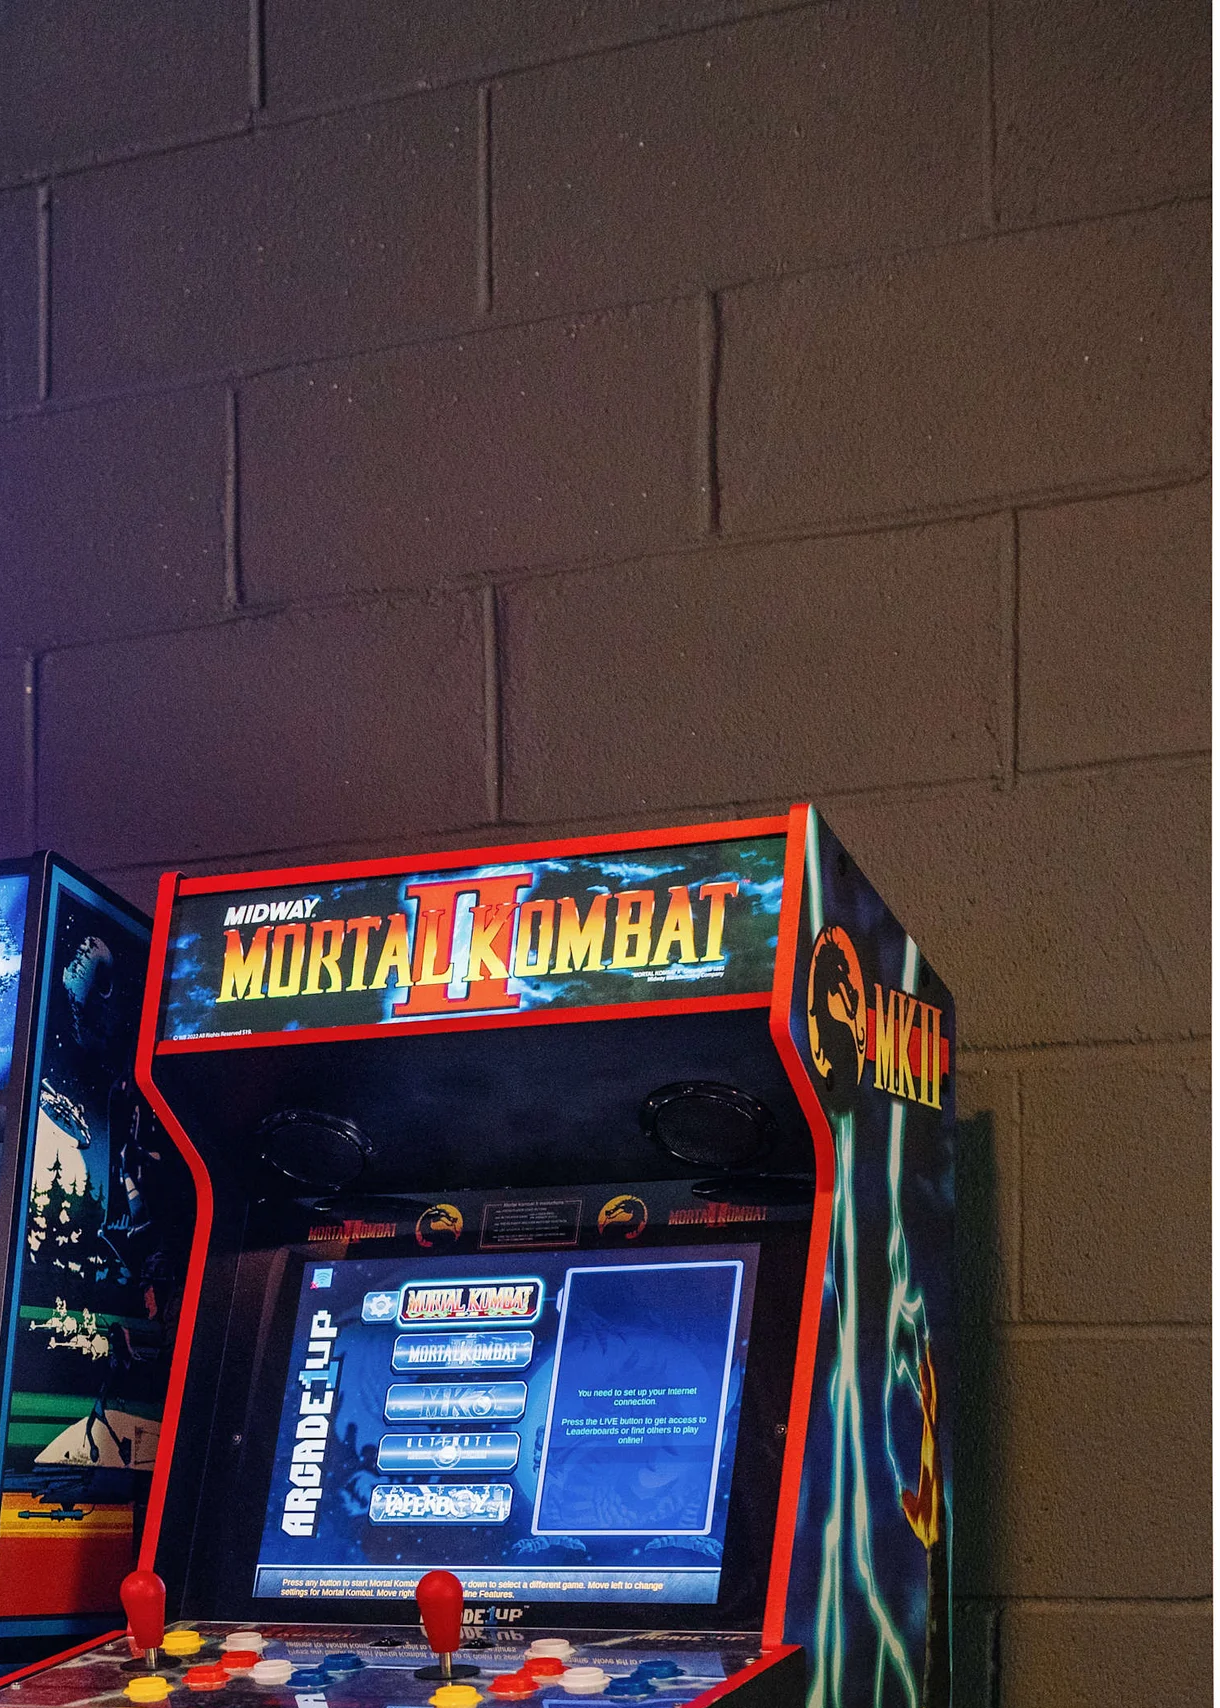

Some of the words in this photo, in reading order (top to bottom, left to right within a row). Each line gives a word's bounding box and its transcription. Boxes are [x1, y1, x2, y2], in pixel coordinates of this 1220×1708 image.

[223, 898, 320, 926] MIDWAY
[215, 908, 466, 1003] MORTAL
[462, 881, 741, 983] KOMBAT
[873, 983, 943, 1111] MKII
[407, 1288, 465, 1313] MORTAL
[467, 1286, 534, 1311] KOMBAT
[407, 1344, 461, 1363] MORTAL
[459, 1342, 517, 1362] KOMBAT
[594, 1389, 612, 1397] need
[614, 1389, 622, 1397] to
[638, 1390, 647, 1398] up
[648, 1389, 666, 1398] your
[668, 1387, 697, 1396] Internet
[562, 1418, 584, 1426] Press
[586, 1417, 597, 1425] the
[599, 1417, 618, 1425] LIVE
[620, 1417, 643, 1425] button
[645, 1417, 652, 1425] to
[655, 1417, 667, 1426] get
[669, 1417, 696, 1425] access
[699, 1416, 707, 1424] to
[566, 1427, 619, 1436] Leaderboards
[647, 1426, 671, 1434] others
[683, 1426, 699, 1434] play
[618, 1436, 643, 1444] online!
[282, 1579, 304, 1587] Press
[305, 1580, 318, 1588] any
[320, 1579, 342, 1587] button
[369, 1580, 392, 1588] Mortal
[498, 1581, 521, 1589] select
[529, 1581, 561, 1589] different
[634, 1582, 663, 1591] change
[281, 1588, 308, 1597] settings
[309, 1588, 319, 1596] for
[321, 1588, 344, 1596] Mortal
[376, 1589, 396, 1597] Move
[399, 1589, 415, 1598] right
[479, 1591, 514, 1599] Features.
